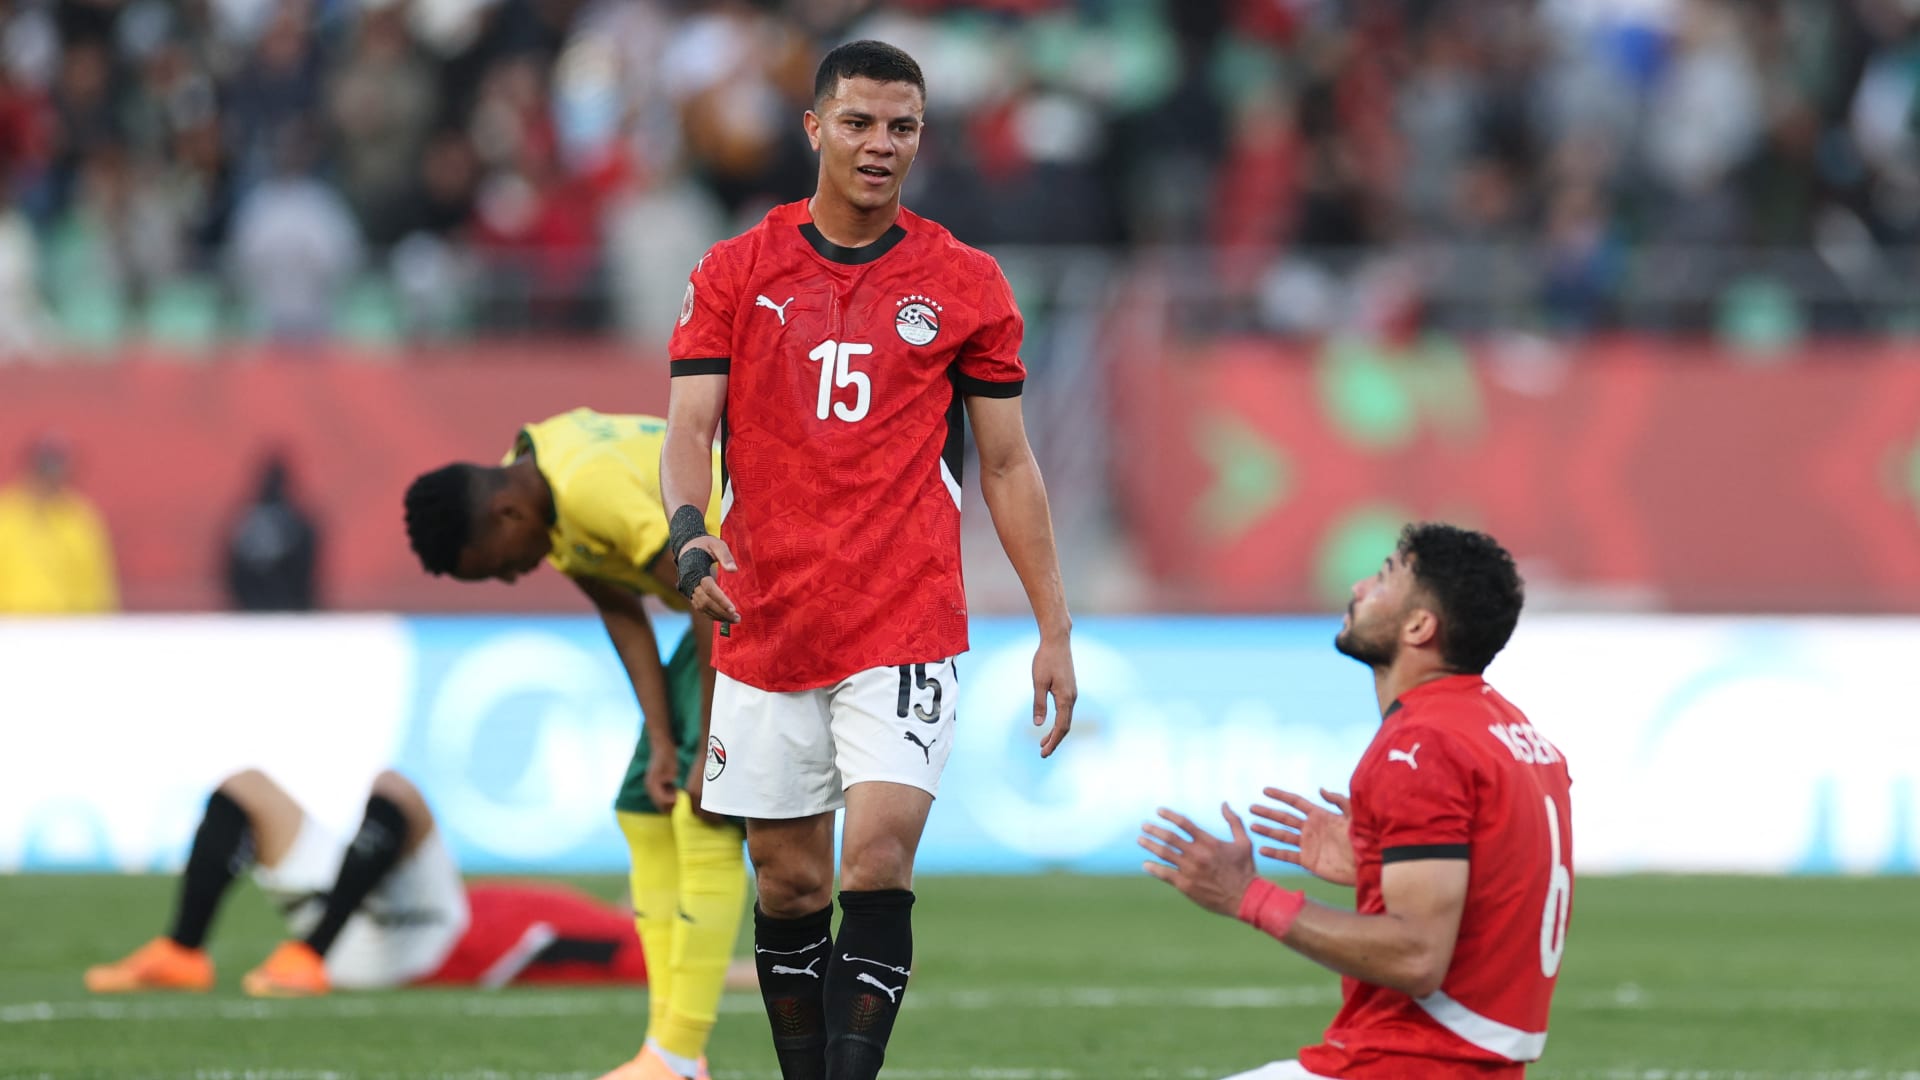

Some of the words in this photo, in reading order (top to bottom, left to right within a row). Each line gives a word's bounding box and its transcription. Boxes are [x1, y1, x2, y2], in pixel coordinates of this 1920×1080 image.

[809, 340, 873, 422] 15
[888, 657, 944, 724] 15
[1540, 795, 1570, 978] 6
